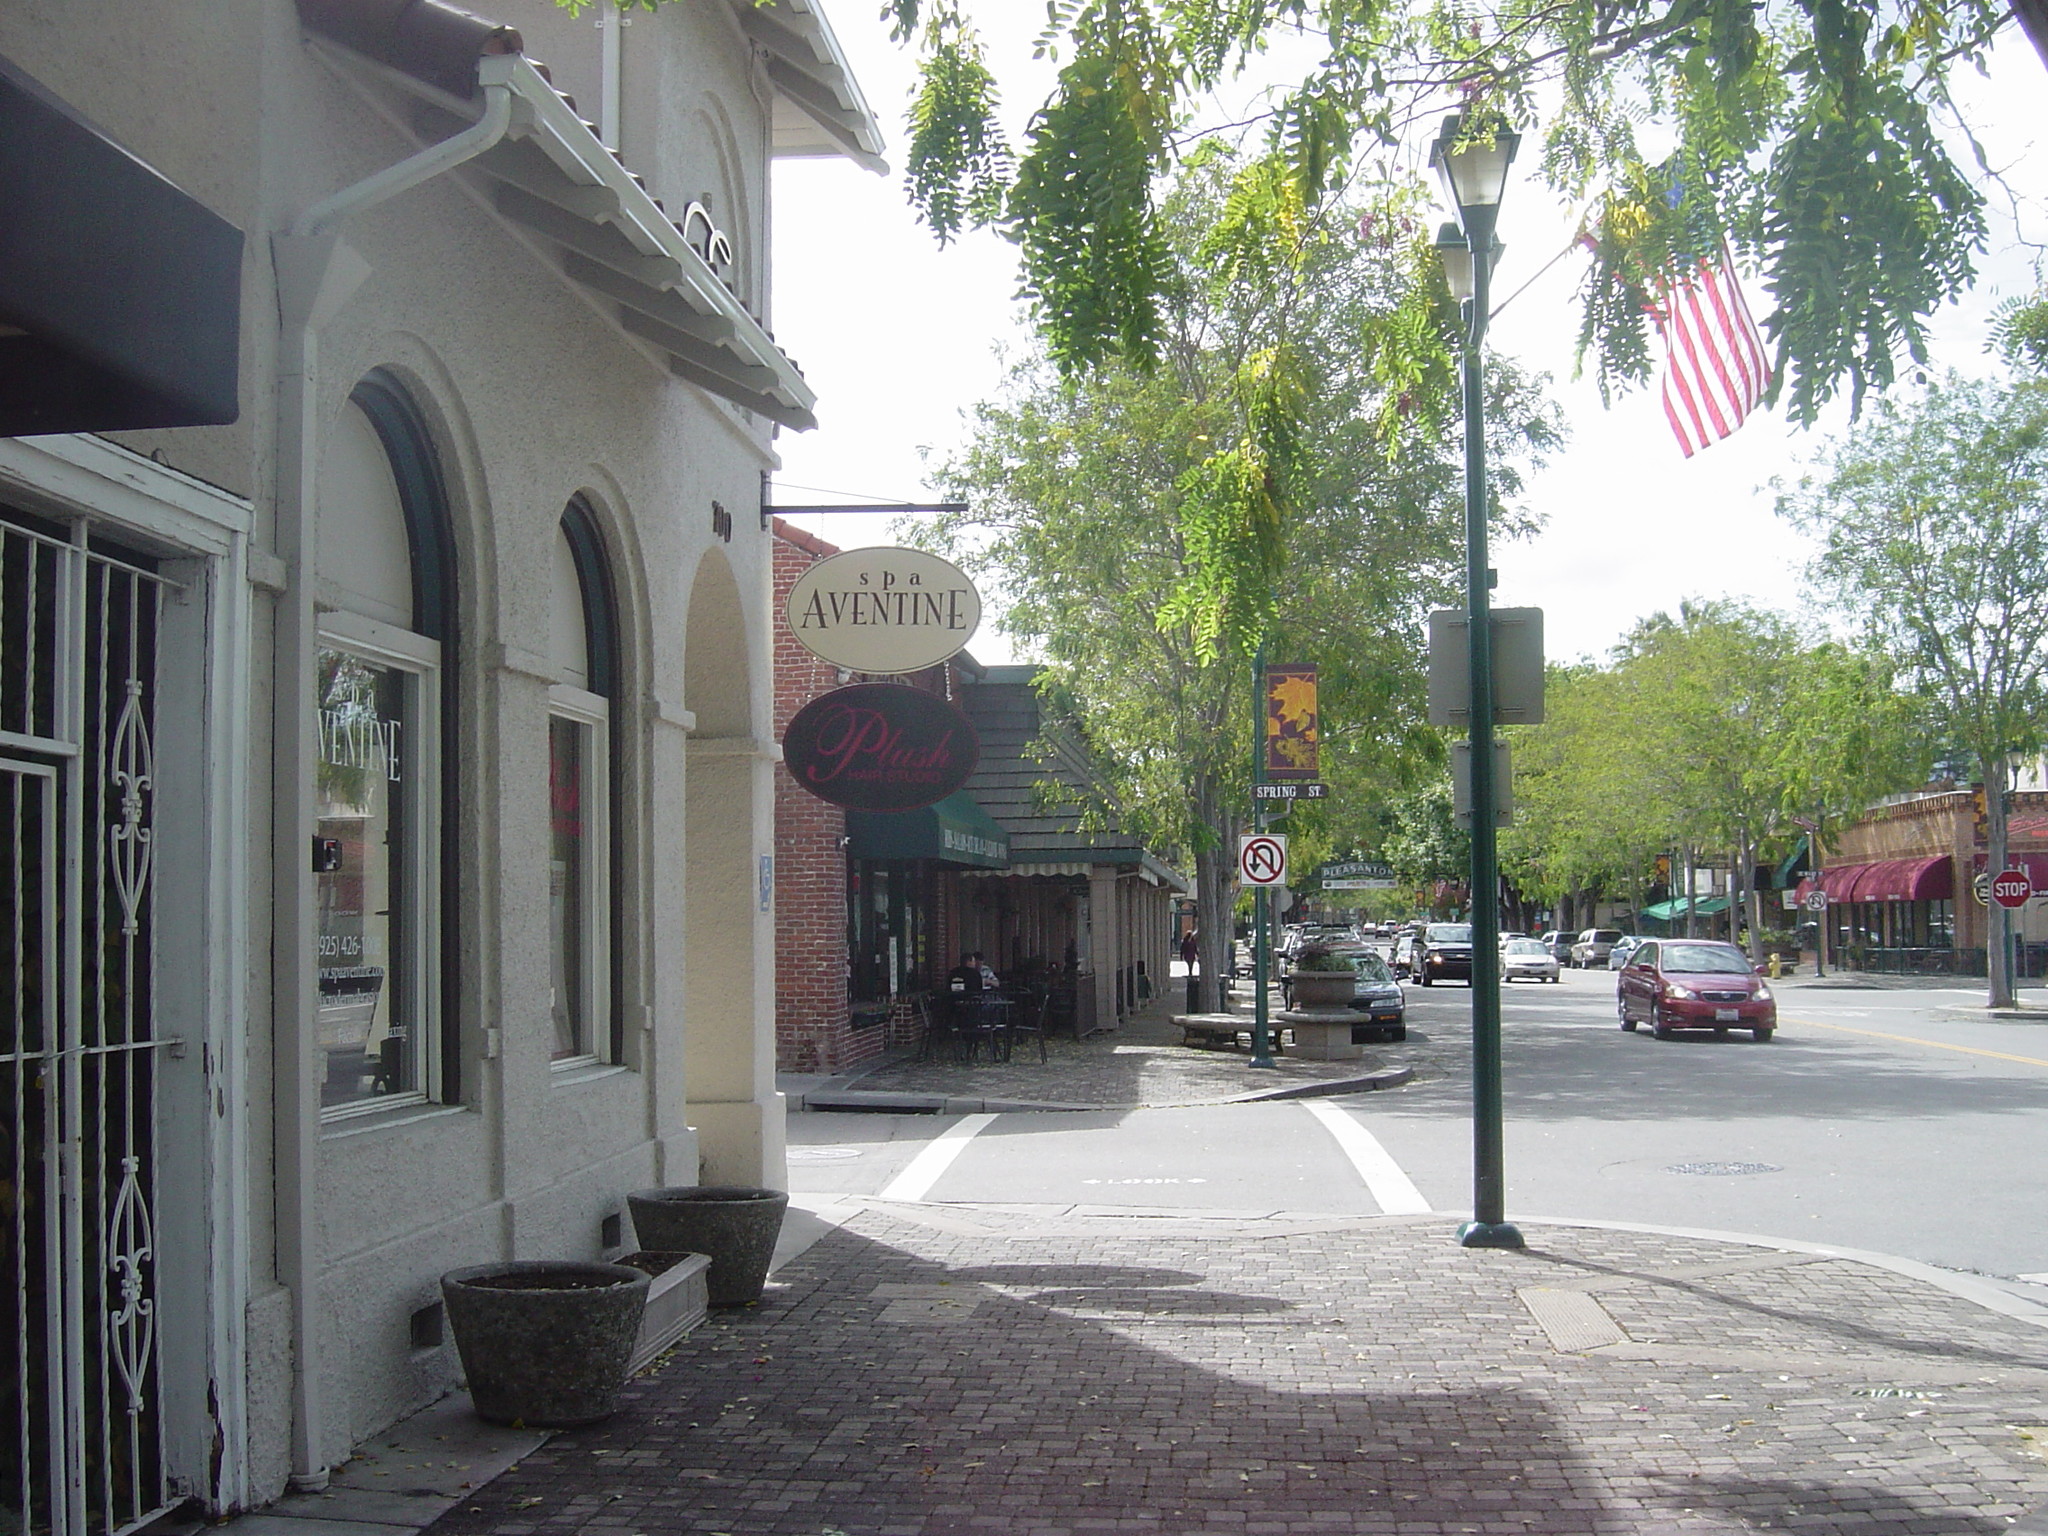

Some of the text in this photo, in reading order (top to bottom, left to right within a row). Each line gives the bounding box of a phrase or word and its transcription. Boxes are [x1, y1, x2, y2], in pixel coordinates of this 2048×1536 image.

[859, 570, 922, 591] spa
[800, 588, 968, 630] AVENTINE
[807, 704, 955, 782] Plush
[1256, 785, 1297, 798] SPRING
[1323, 864, 1395, 878] PLEASANTON
[1995, 882, 2029, 897] STOP
